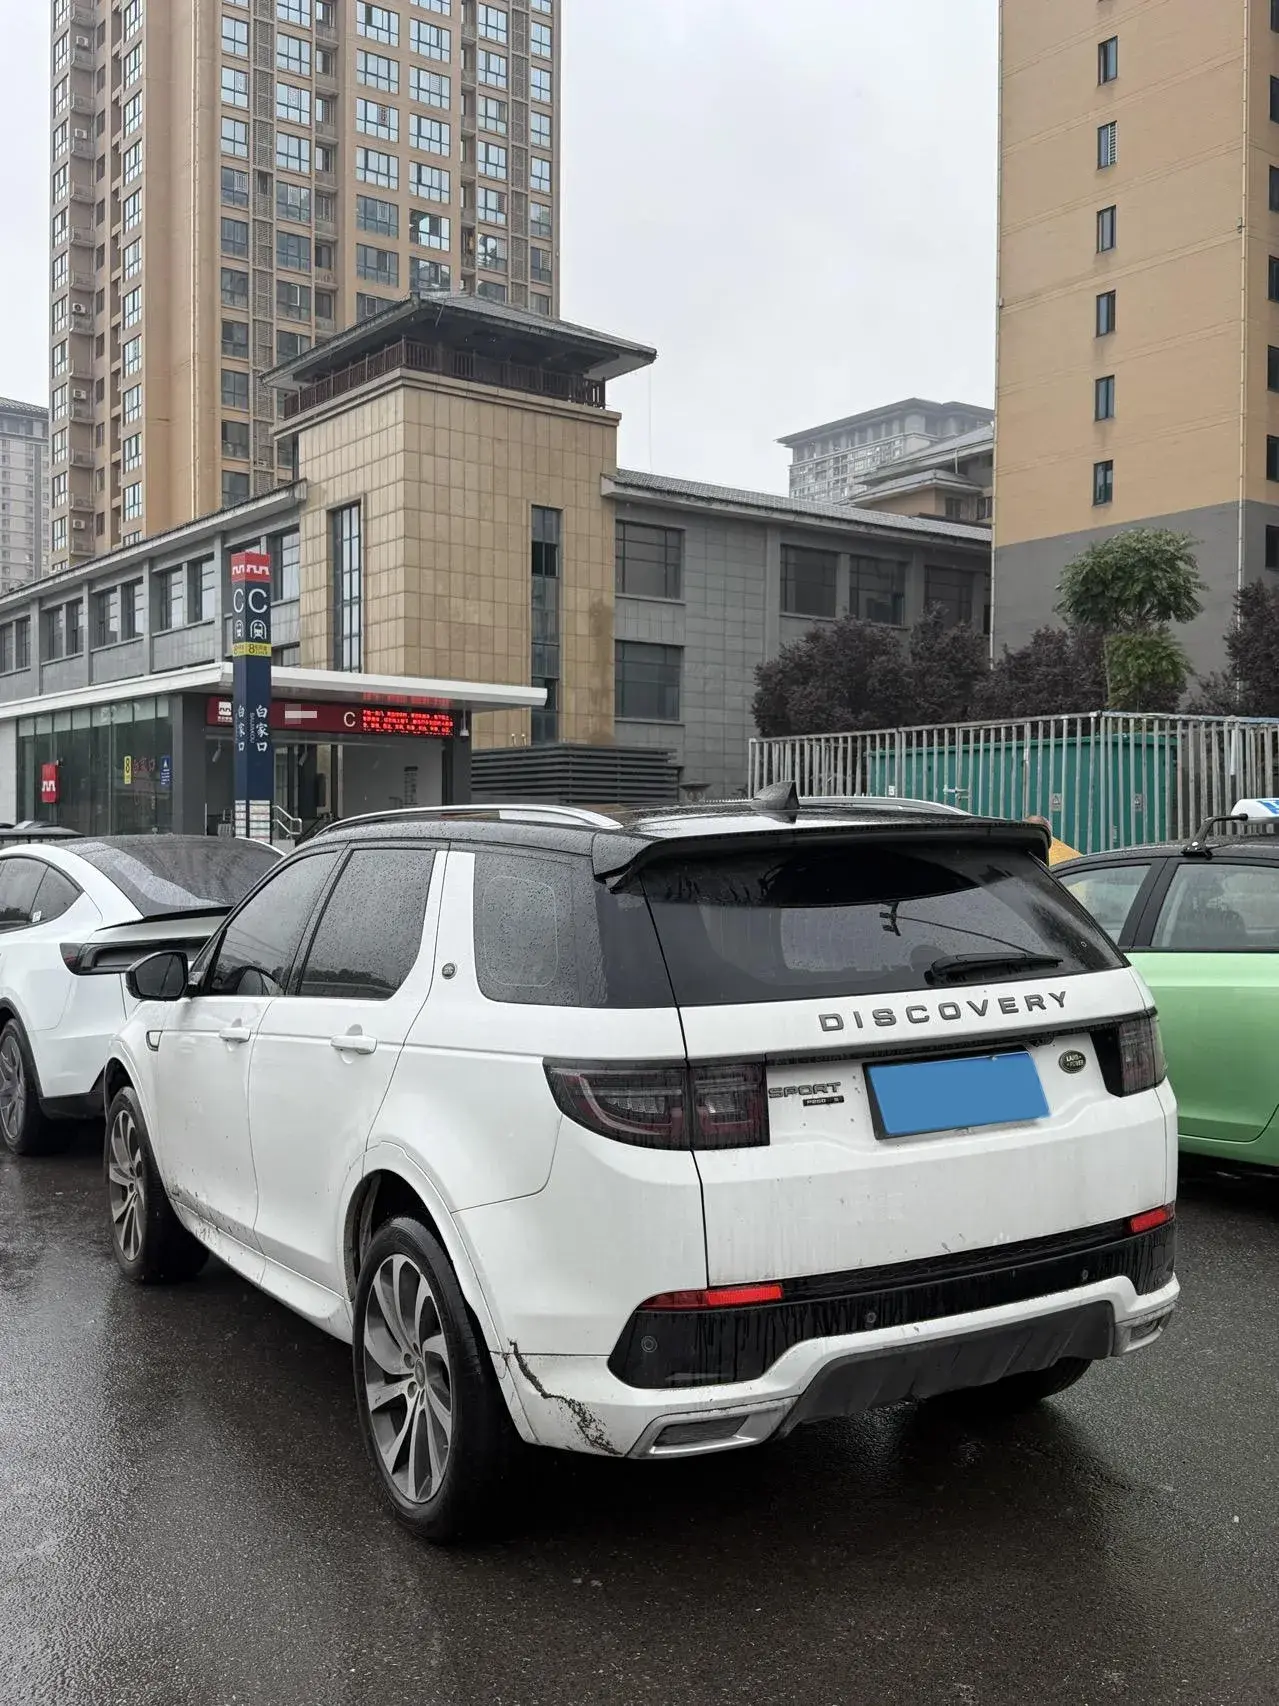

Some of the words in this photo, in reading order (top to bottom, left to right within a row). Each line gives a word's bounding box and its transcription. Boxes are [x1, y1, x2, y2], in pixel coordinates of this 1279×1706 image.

[233, 588, 244, 613] C
[248, 588, 268, 613] C
[248, 643, 255, 655] 8
[238, 704, 246, 752] 白家口
[256, 704, 269, 752] 白家口
[343, 711, 356, 727] C
[125, 757, 131, 773] 8
[818, 991, 1067, 1031] DISCOVERY
[768, 1082, 841, 1098] SPORT
